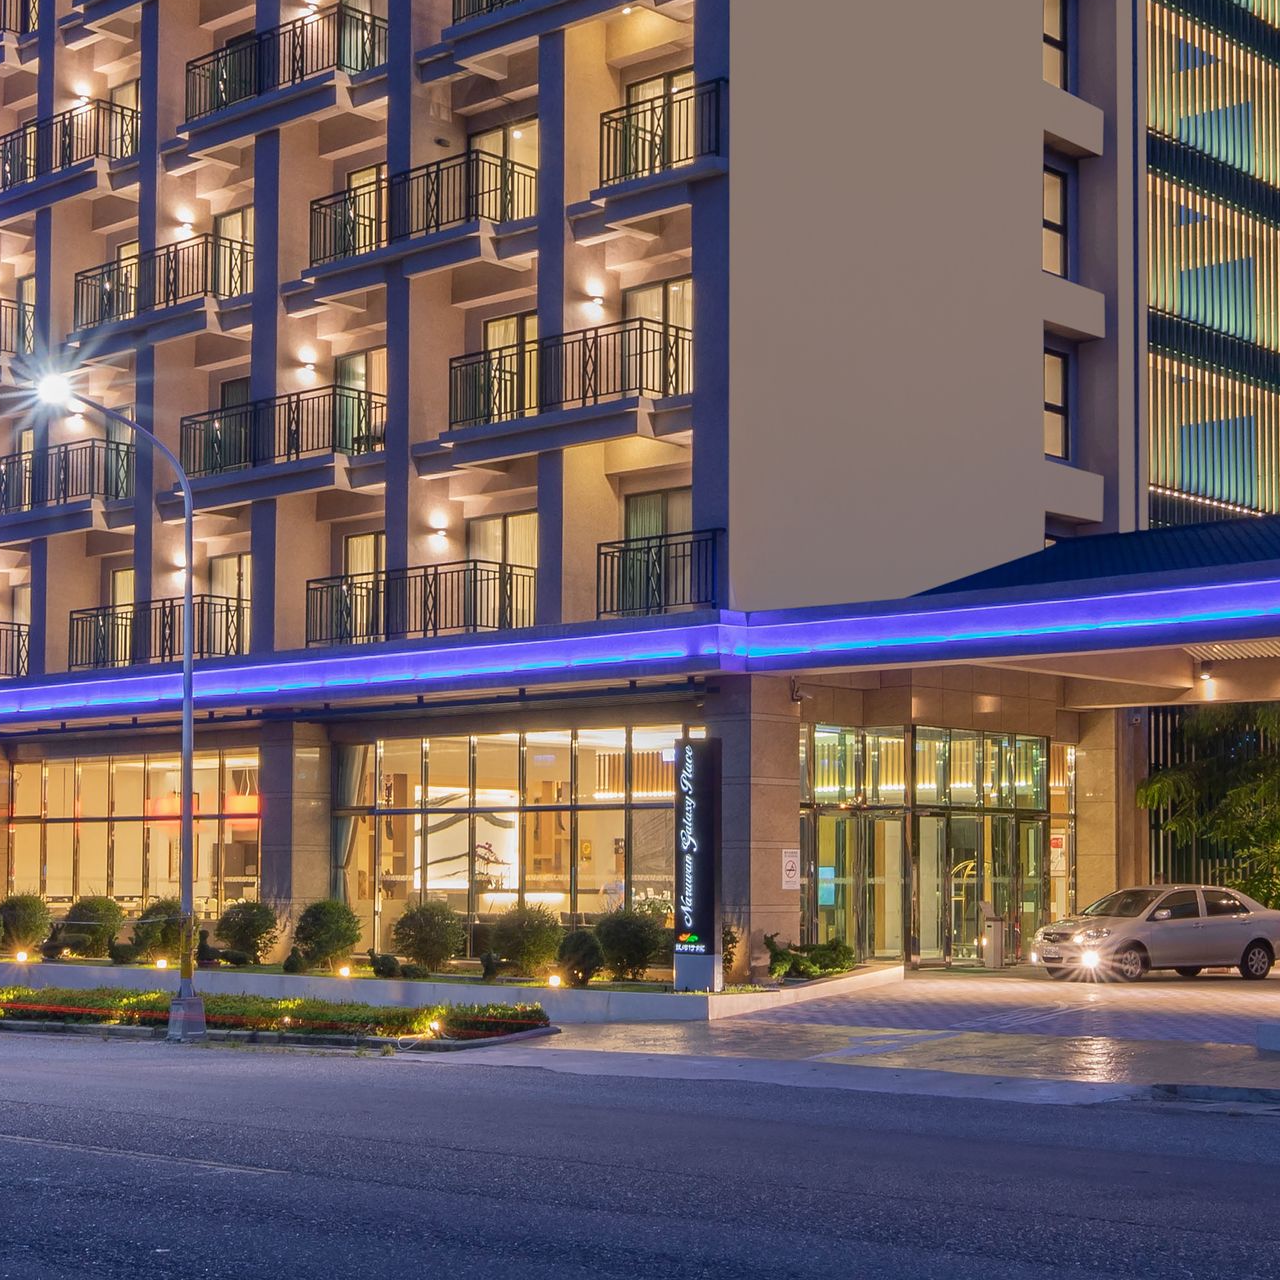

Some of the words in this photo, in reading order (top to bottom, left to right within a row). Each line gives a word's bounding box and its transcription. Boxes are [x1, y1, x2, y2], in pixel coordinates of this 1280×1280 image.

[679, 744, 694, 795] Place
[679, 798, 698, 853] Galaxy
[678, 854, 694, 928] Naruwan
